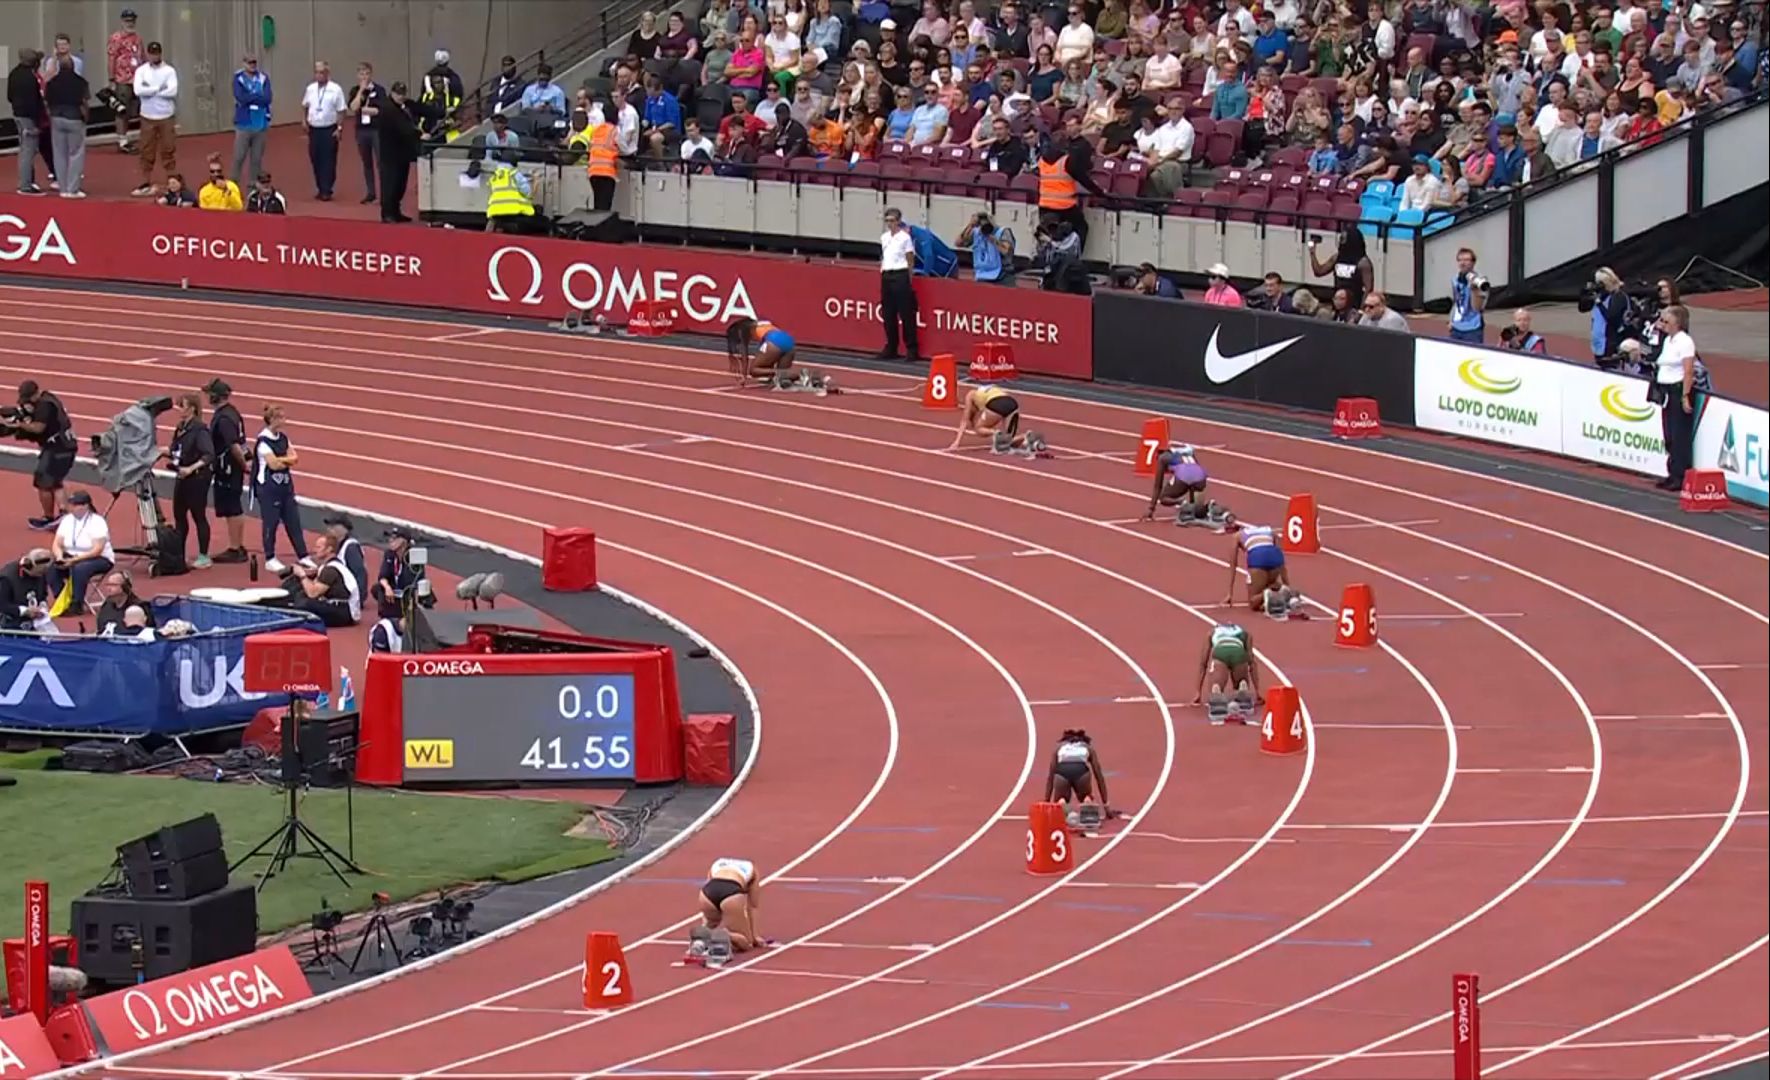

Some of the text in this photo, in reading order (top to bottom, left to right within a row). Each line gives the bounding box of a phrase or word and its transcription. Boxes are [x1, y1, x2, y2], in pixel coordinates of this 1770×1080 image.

[152, 235, 422, 276] OFFICIAL TIMEKEEPER
[562, 262, 757, 323] OMEGA
[933, 309, 1059, 344] TIMEKEEPER
[932, 374, 947, 400] 8
[1438, 395, 1538, 426] LLOYD COWAN
[1582, 421, 1621, 444] LLOYD
[1143, 439, 1159, 465] 7
[1287, 516, 1303, 544] 6
[1340, 608, 1355, 637] 5
[1369, 607, 1378, 636] 5
[423, 661, 484, 675] OMEGA
[558, 685, 619, 719] 0.0
[1262, 711, 1274, 741] 4
[1290, 710, 1302, 740] 4
[410, 744, 450, 764] WL
[520, 736, 630, 770] 41.55
[1025, 829, 1034, 862] 3
[1050, 829, 1066, 862] 3
[31, 904, 41, 948] OMEGA
[602, 961, 622, 996] 2
[165, 964, 284, 1028] OMEGA
[1458, 996, 1469, 1043] OMEGA
